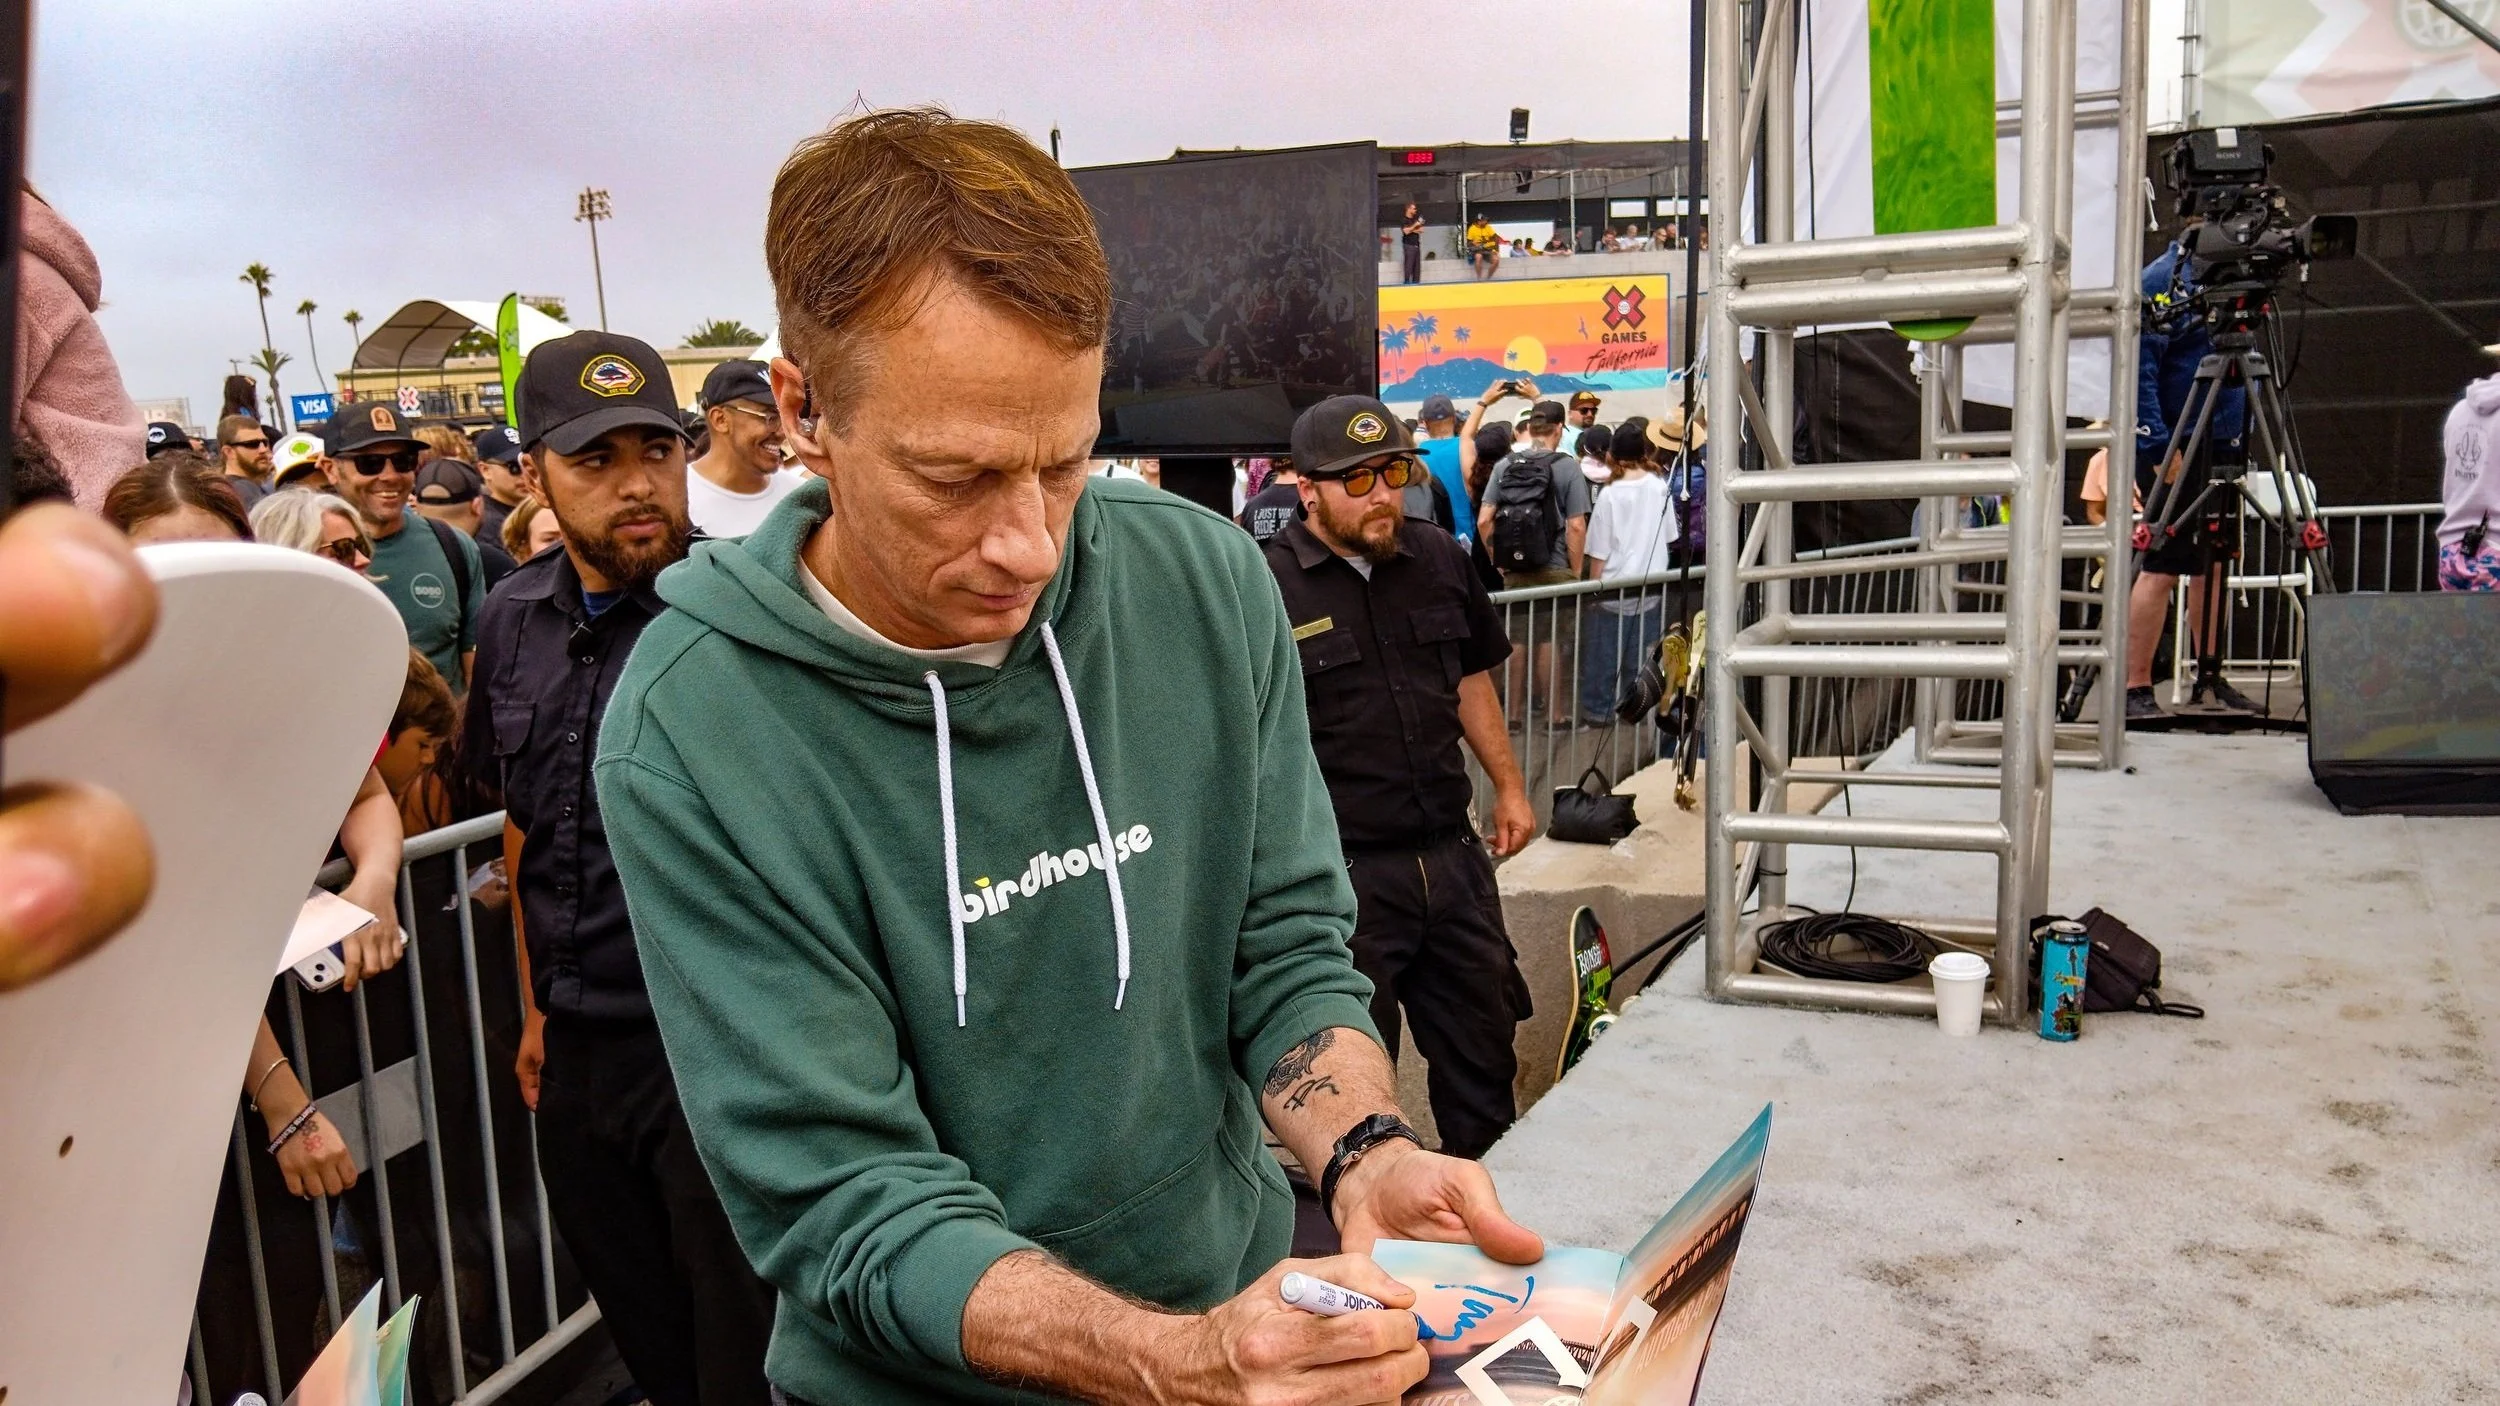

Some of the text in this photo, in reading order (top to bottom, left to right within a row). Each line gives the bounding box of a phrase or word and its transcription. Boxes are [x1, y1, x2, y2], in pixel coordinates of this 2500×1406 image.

[1602, 332, 1646, 344] GAMES
[1584, 342, 1659, 379] California
[297, 399, 329, 415] VISA
[1258, 508, 1277, 520] JUST
[1254, 520, 1276, 535] RIDE
[961, 824, 1153, 923] birdhouse
